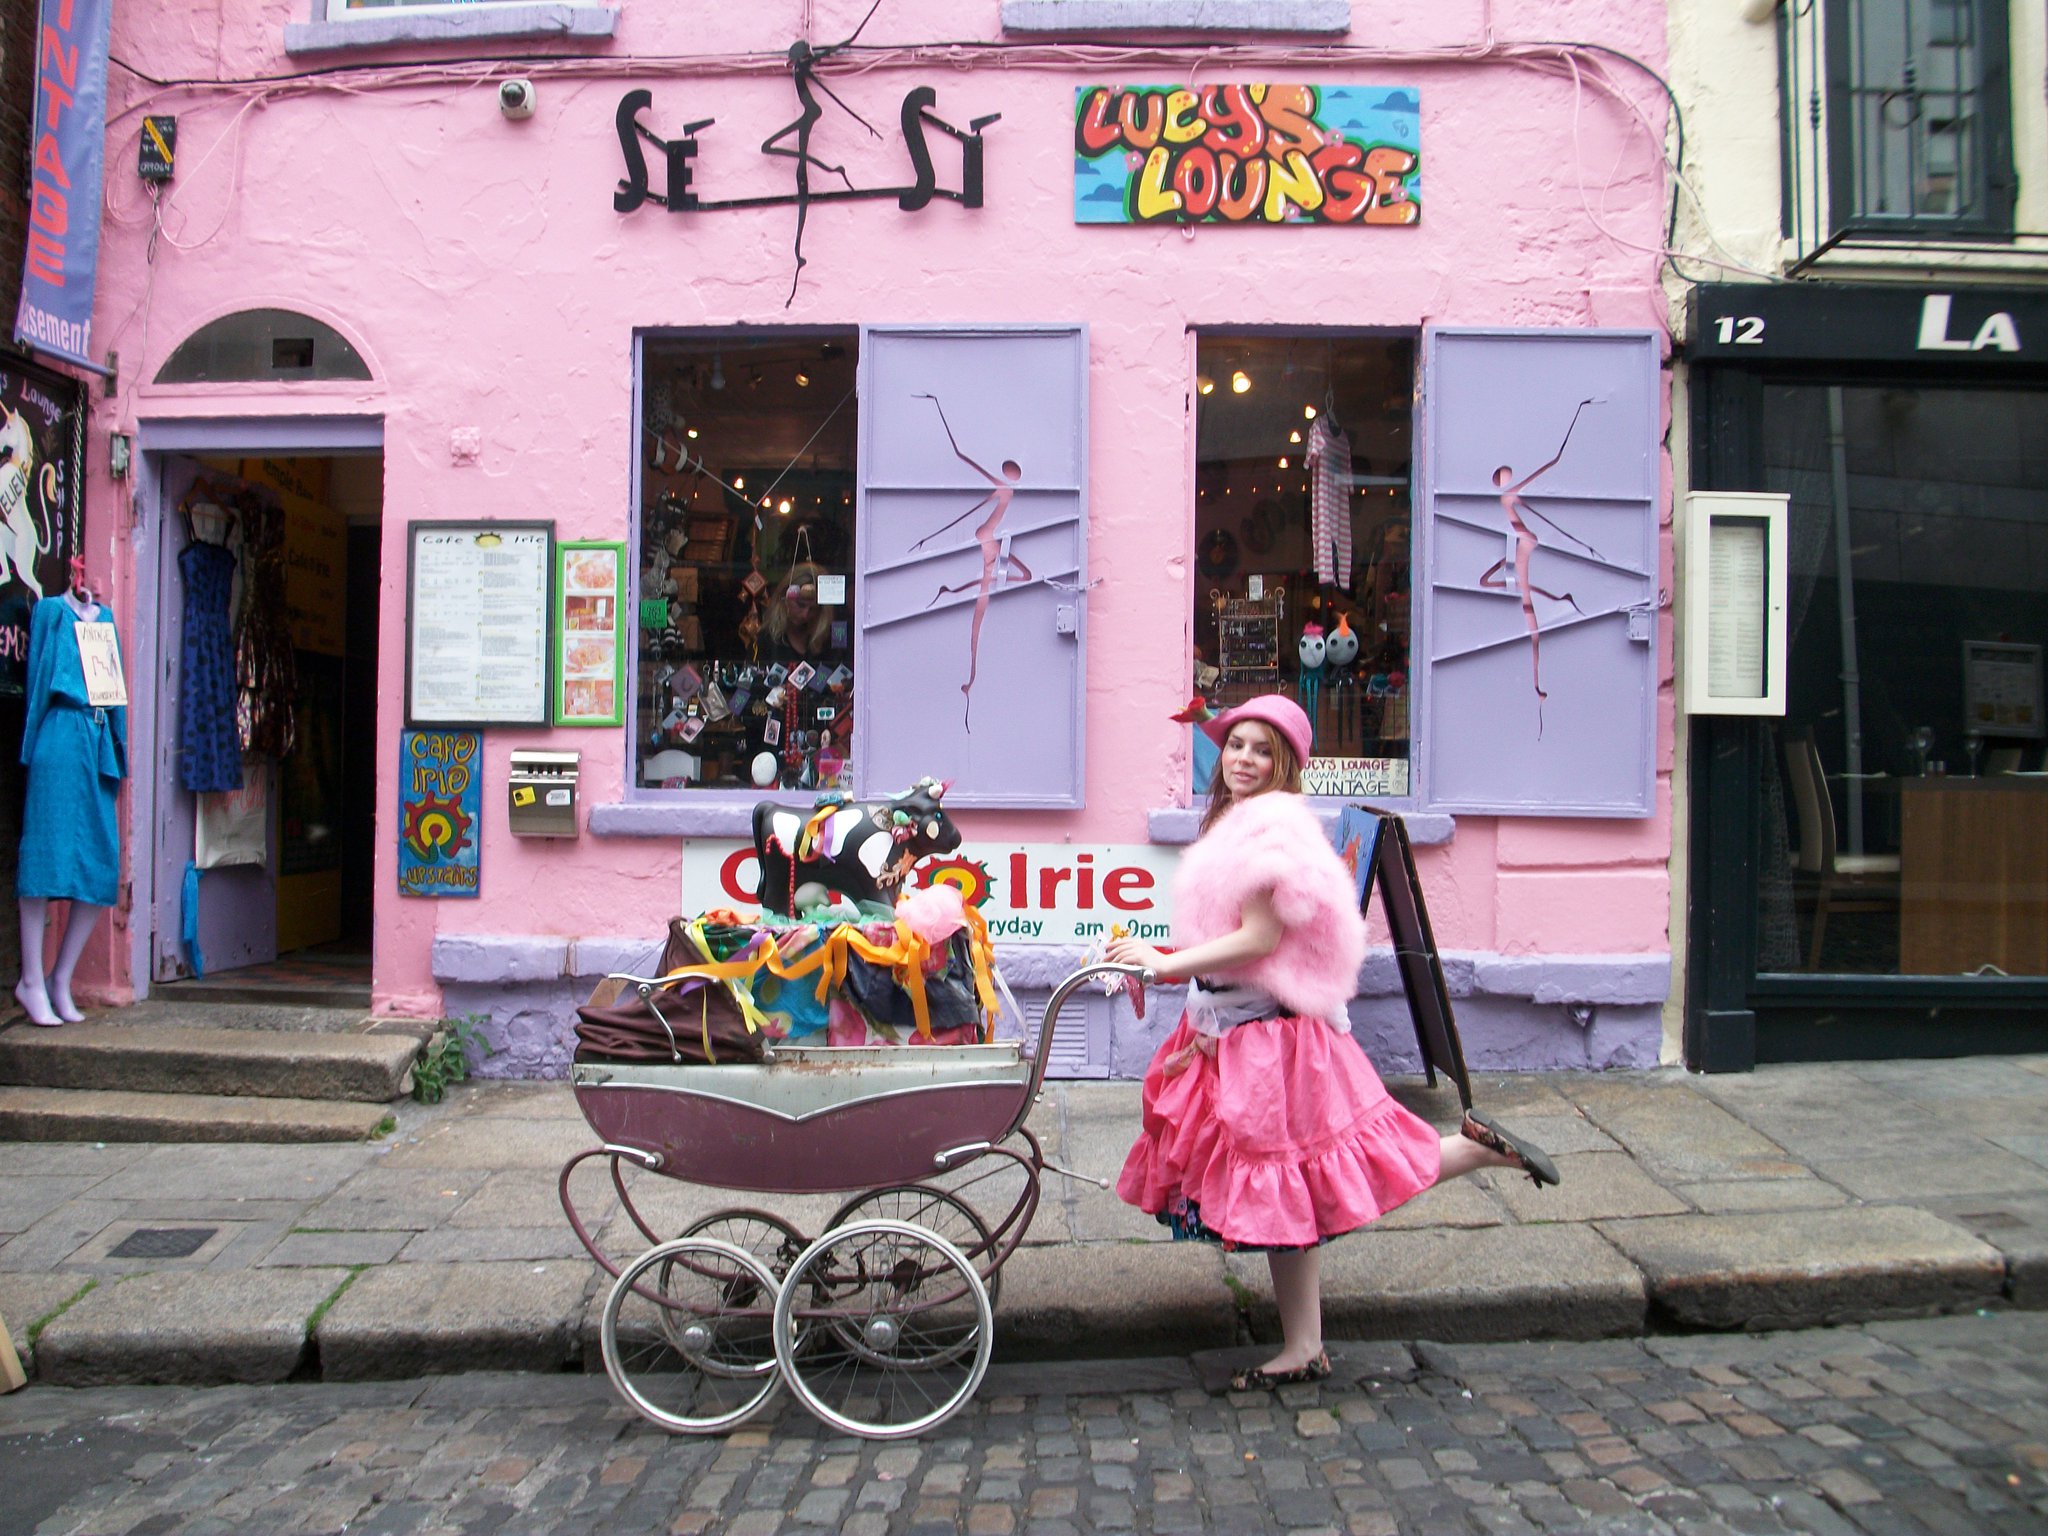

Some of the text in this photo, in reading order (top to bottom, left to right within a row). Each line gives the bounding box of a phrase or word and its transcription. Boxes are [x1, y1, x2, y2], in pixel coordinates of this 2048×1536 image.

[27, 0, 79, 287] INTAGE
[1138, 143, 1420, 224] LOUNGE
[1714, 316, 1765, 344] 12
[423, 536, 545, 544] Cafe Irie
[413, 759, 471, 795] irie
[1304, 759, 1391, 771] UCY'S LOUNGE
[1309, 780, 1391, 796] VINTAGE
[1009, 853, 1155, 911] Irie
[988, 916, 1043, 936] ryday
[1074, 922, 1104, 936] am
